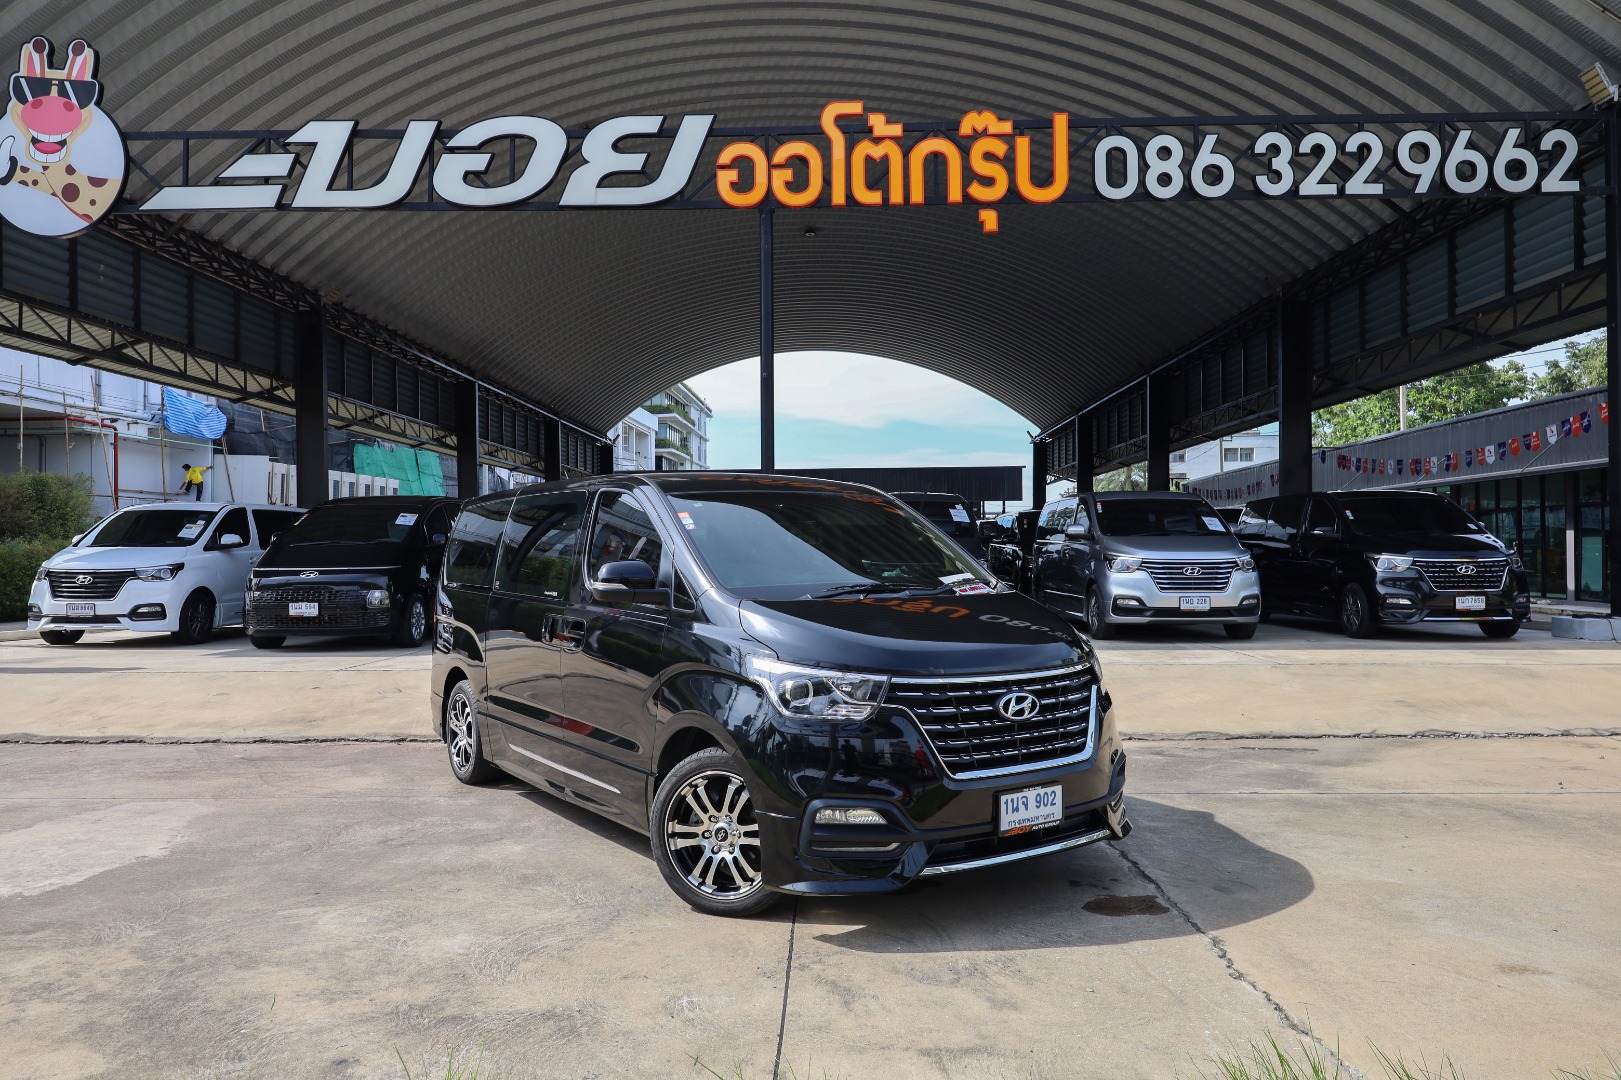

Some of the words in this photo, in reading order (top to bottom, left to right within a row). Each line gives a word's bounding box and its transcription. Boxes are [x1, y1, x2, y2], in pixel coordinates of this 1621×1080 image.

[284, 114, 717, 209] บอย
[715, 100, 1070, 234] ออโต้กรุ๊ป
[1093, 132, 1236, 200] 086
[1003, 796, 1028, 815] 1นจ
[1035, 790, 1057, 809] 902
